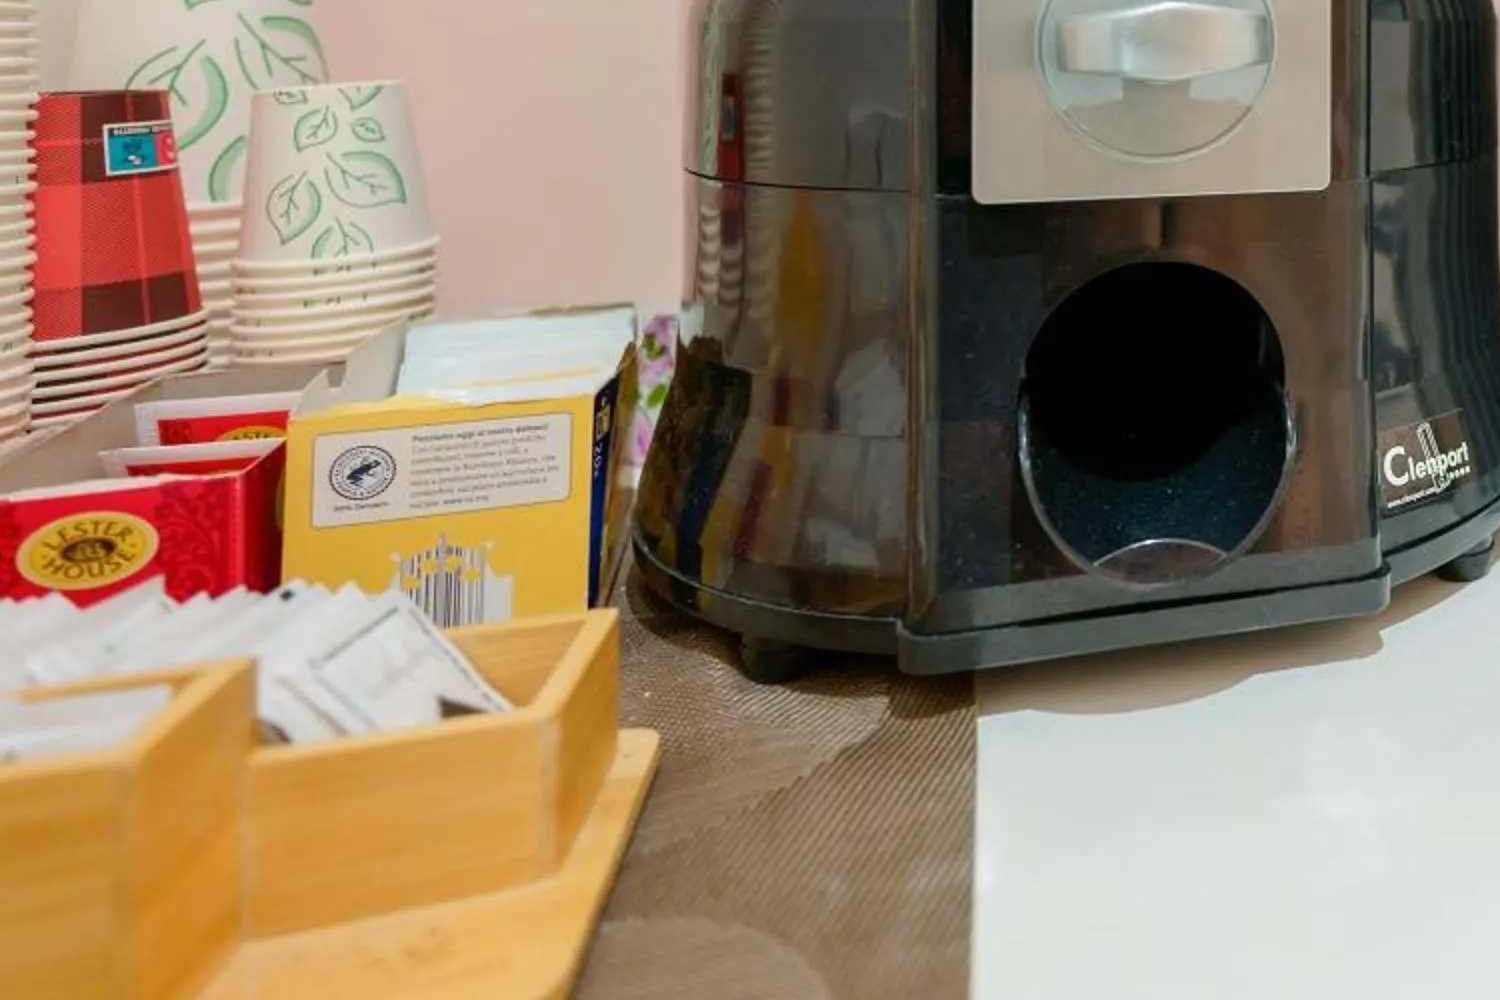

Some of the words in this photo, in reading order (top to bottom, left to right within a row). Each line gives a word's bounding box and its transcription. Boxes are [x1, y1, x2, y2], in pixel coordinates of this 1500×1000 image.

[1383, 441, 1470, 487] Clenport
[41, 519, 133, 552] LESTER
[41, 549, 135, 579] HOUSE
